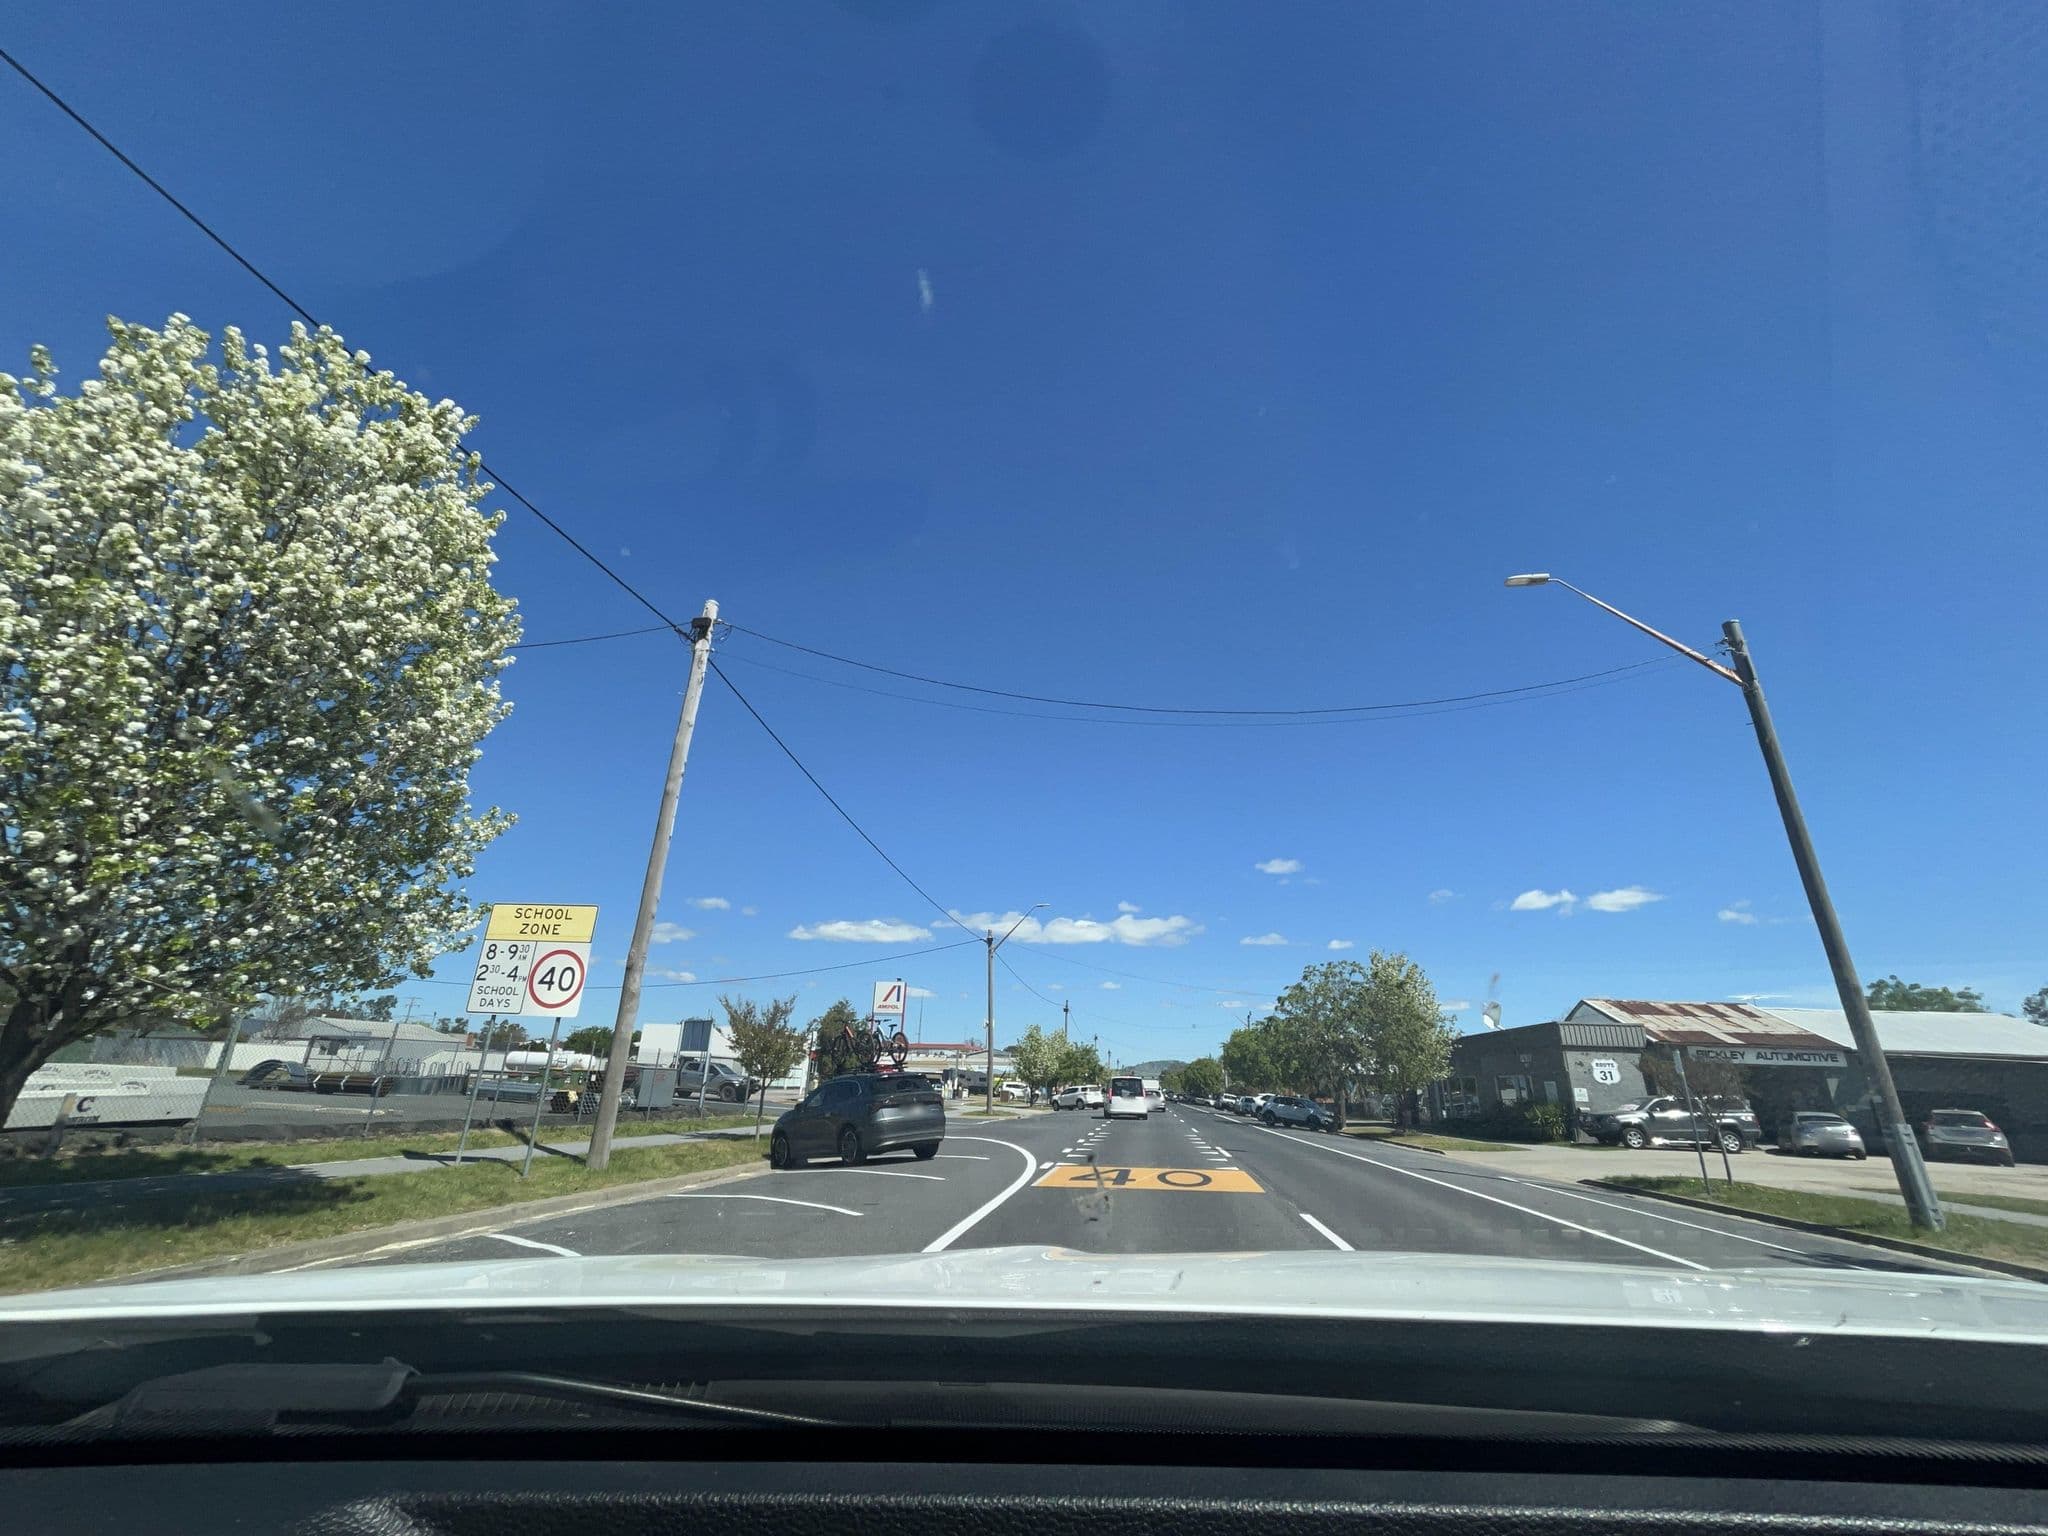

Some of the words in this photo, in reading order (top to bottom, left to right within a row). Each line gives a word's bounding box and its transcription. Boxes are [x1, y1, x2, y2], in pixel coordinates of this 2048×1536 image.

[514, 908, 573, 920] SCHOOL
[519, 923, 561, 935] ZONE
[537, 966, 576, 992] 40
[477, 985, 519, 996] SCHOOL
[479, 998, 511, 1008] DAYS
[1755, 1050, 1839, 1063] AUTOMOTIVE
[1599, 1070, 1614, 1081] 31
[1068, 1168, 1213, 1188] 40
